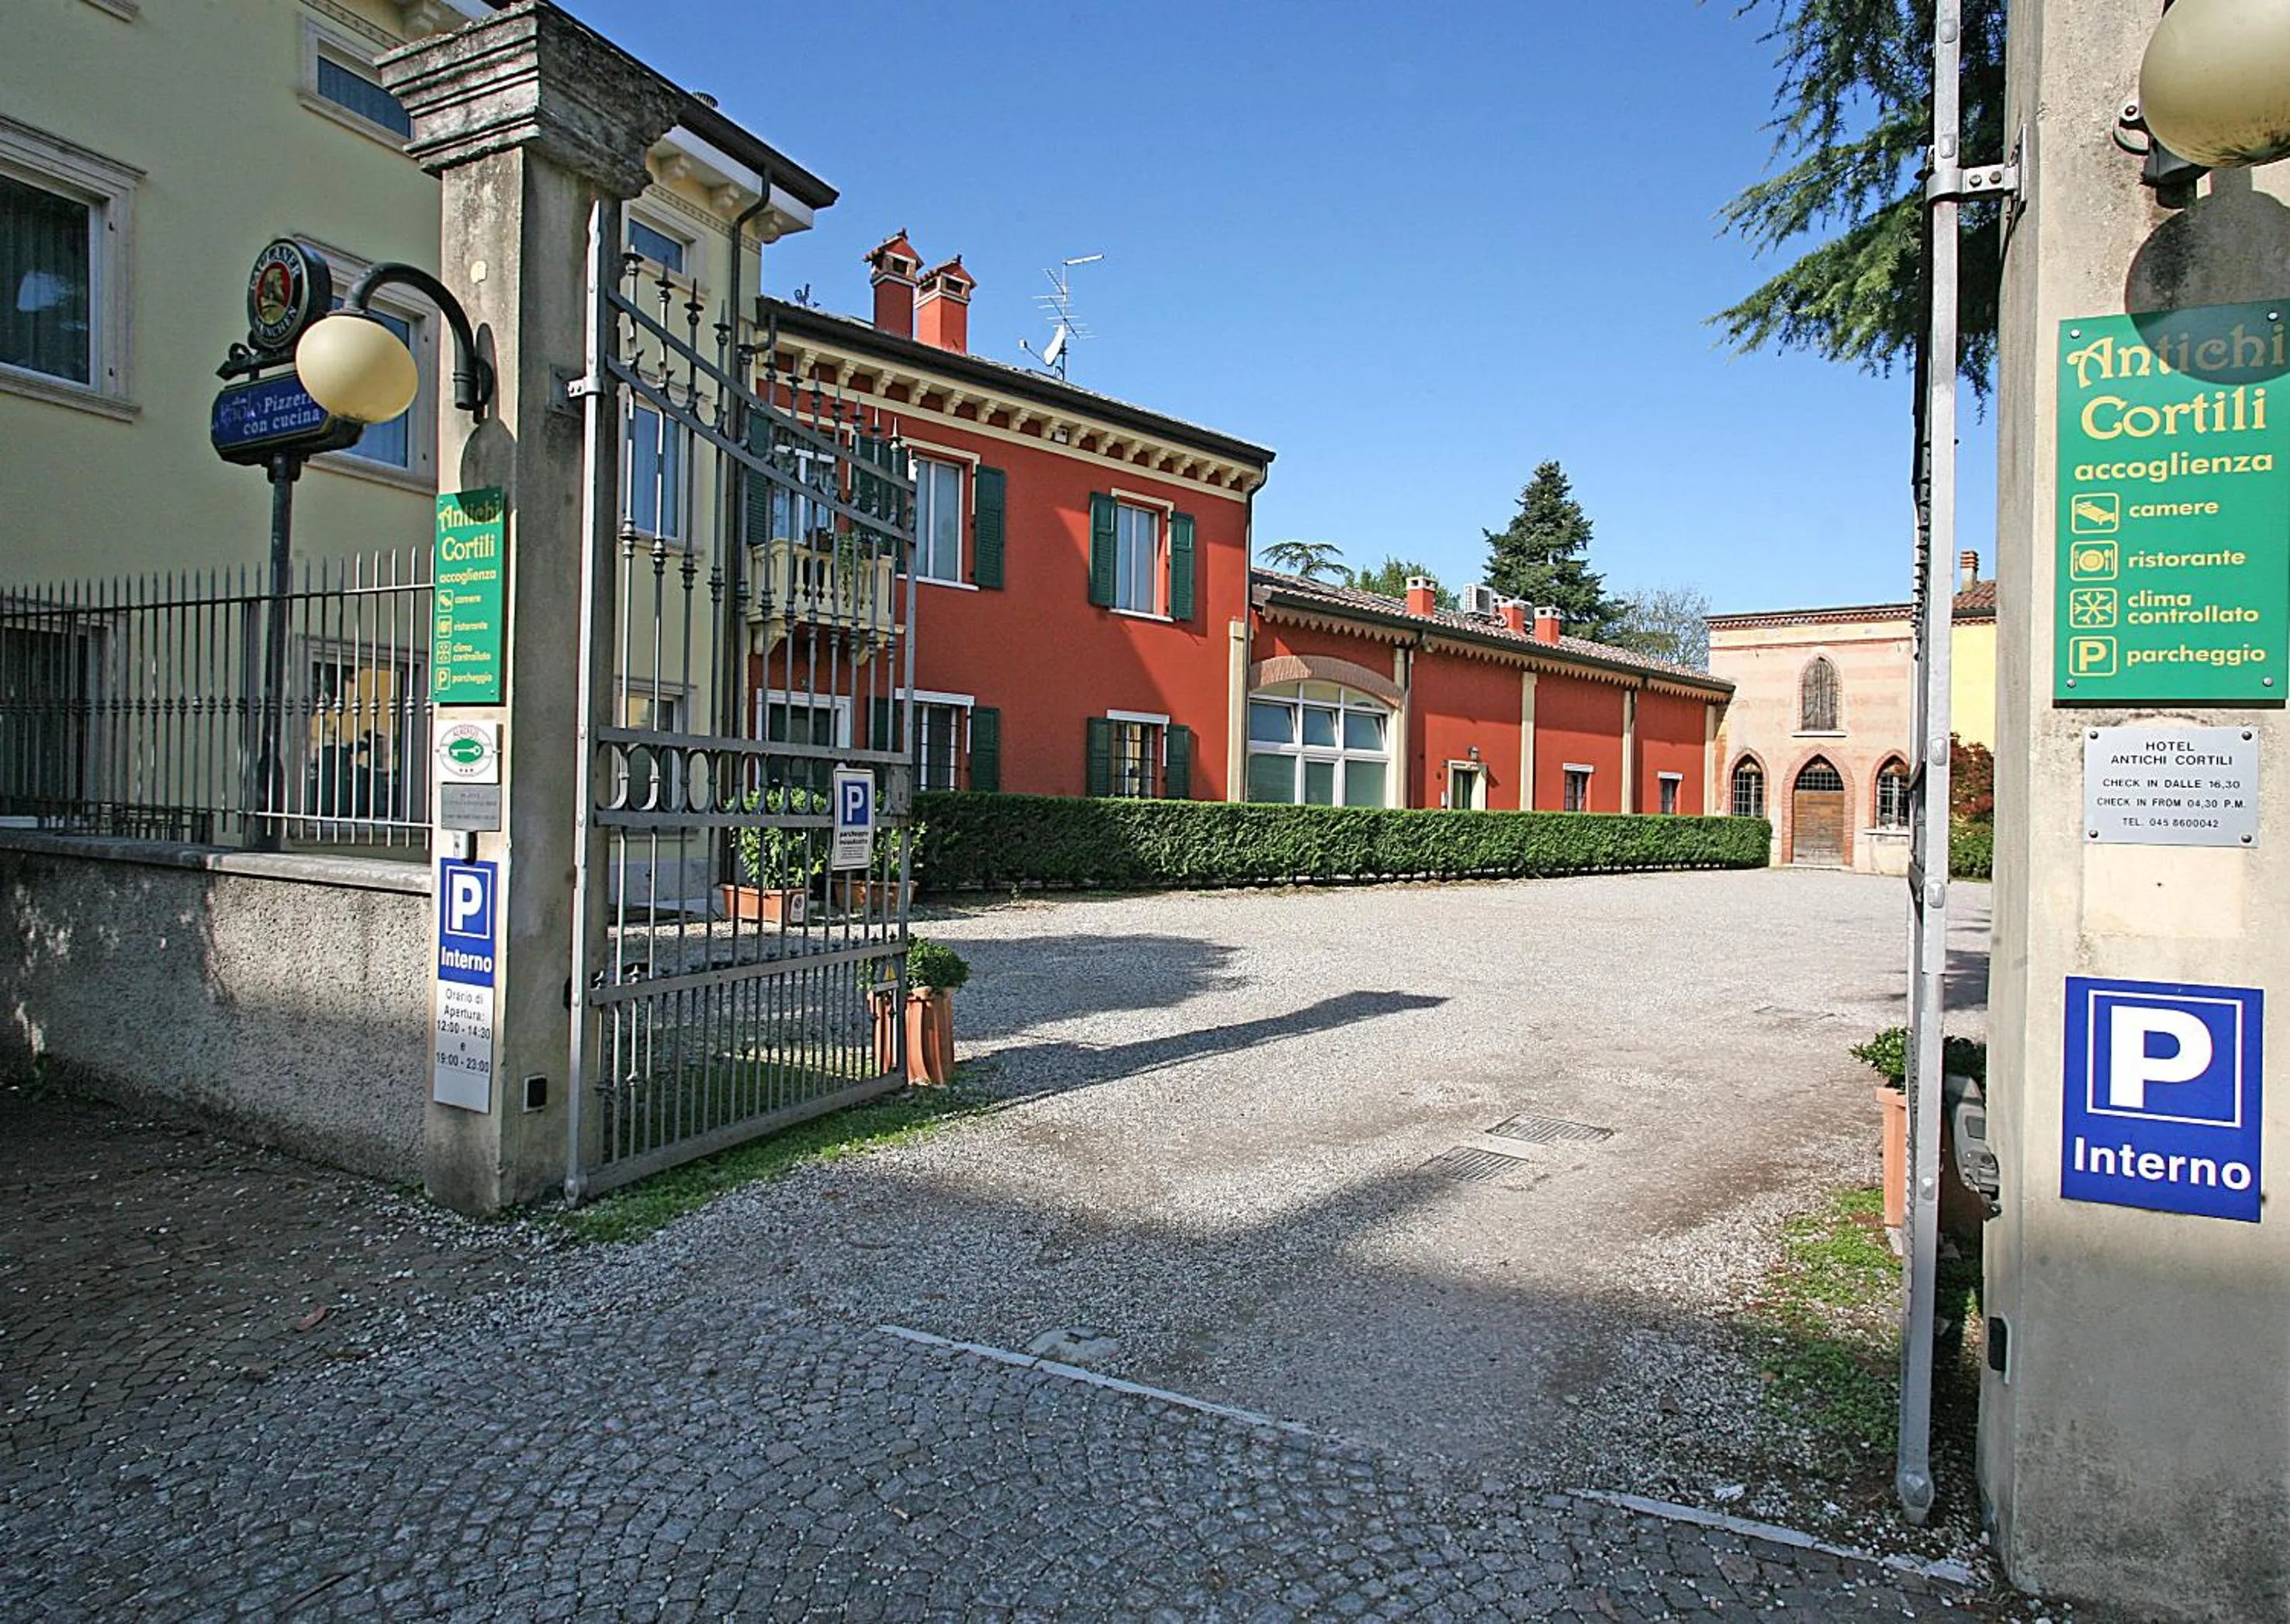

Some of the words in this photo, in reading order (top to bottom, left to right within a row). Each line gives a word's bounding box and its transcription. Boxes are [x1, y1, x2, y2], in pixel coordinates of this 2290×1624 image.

[2067, 323, 2285, 388] Antichi
[243, 421, 268, 436] con
[272, 408, 320, 430] cucina
[2081, 385, 2266, 440] Cortili
[2074, 451, 2273, 483] accoglienza
[438, 500, 500, 533] Antichi
[2129, 501, 2219, 518] camere
[441, 534, 495, 561] Cortili
[2128, 550, 2247, 568] ristorante
[439, 568, 496, 586] accoglienza
[2127, 590, 2192, 608] clima
[2127, 605, 2260, 624] controllato
[2078, 640, 2108, 672] P
[2126, 644, 2267, 667] parcheggio
[2146, 741, 2195, 752] HOTEL
[2111, 755, 2167, 765] ANTICHI
[2175, 755, 2233, 766] CORTILI
[2102, 778, 2140, 787] CHECK
[2147, 779, 2158, 787] IN
[2164, 779, 2202, 788] DALLE
[846, 785, 864, 822] P
[2097, 797, 2130, 807] CHECK
[2136, 798, 2146, 807] IN
[2152, 798, 2181, 807] FROM
[2224, 800, 2247, 808] P.M.
[2122, 817, 2144, 826] TEL.
[2149, 818, 2169, 827] 045
[451, 873, 483, 930] P
[441, 946, 493, 973] Interno
[445, 988, 472, 1004] Orario
[461, 1042, 465, 1052] e
[2109, 1005, 2214, 1108] P
[2074, 1136, 2252, 1190] Interno
